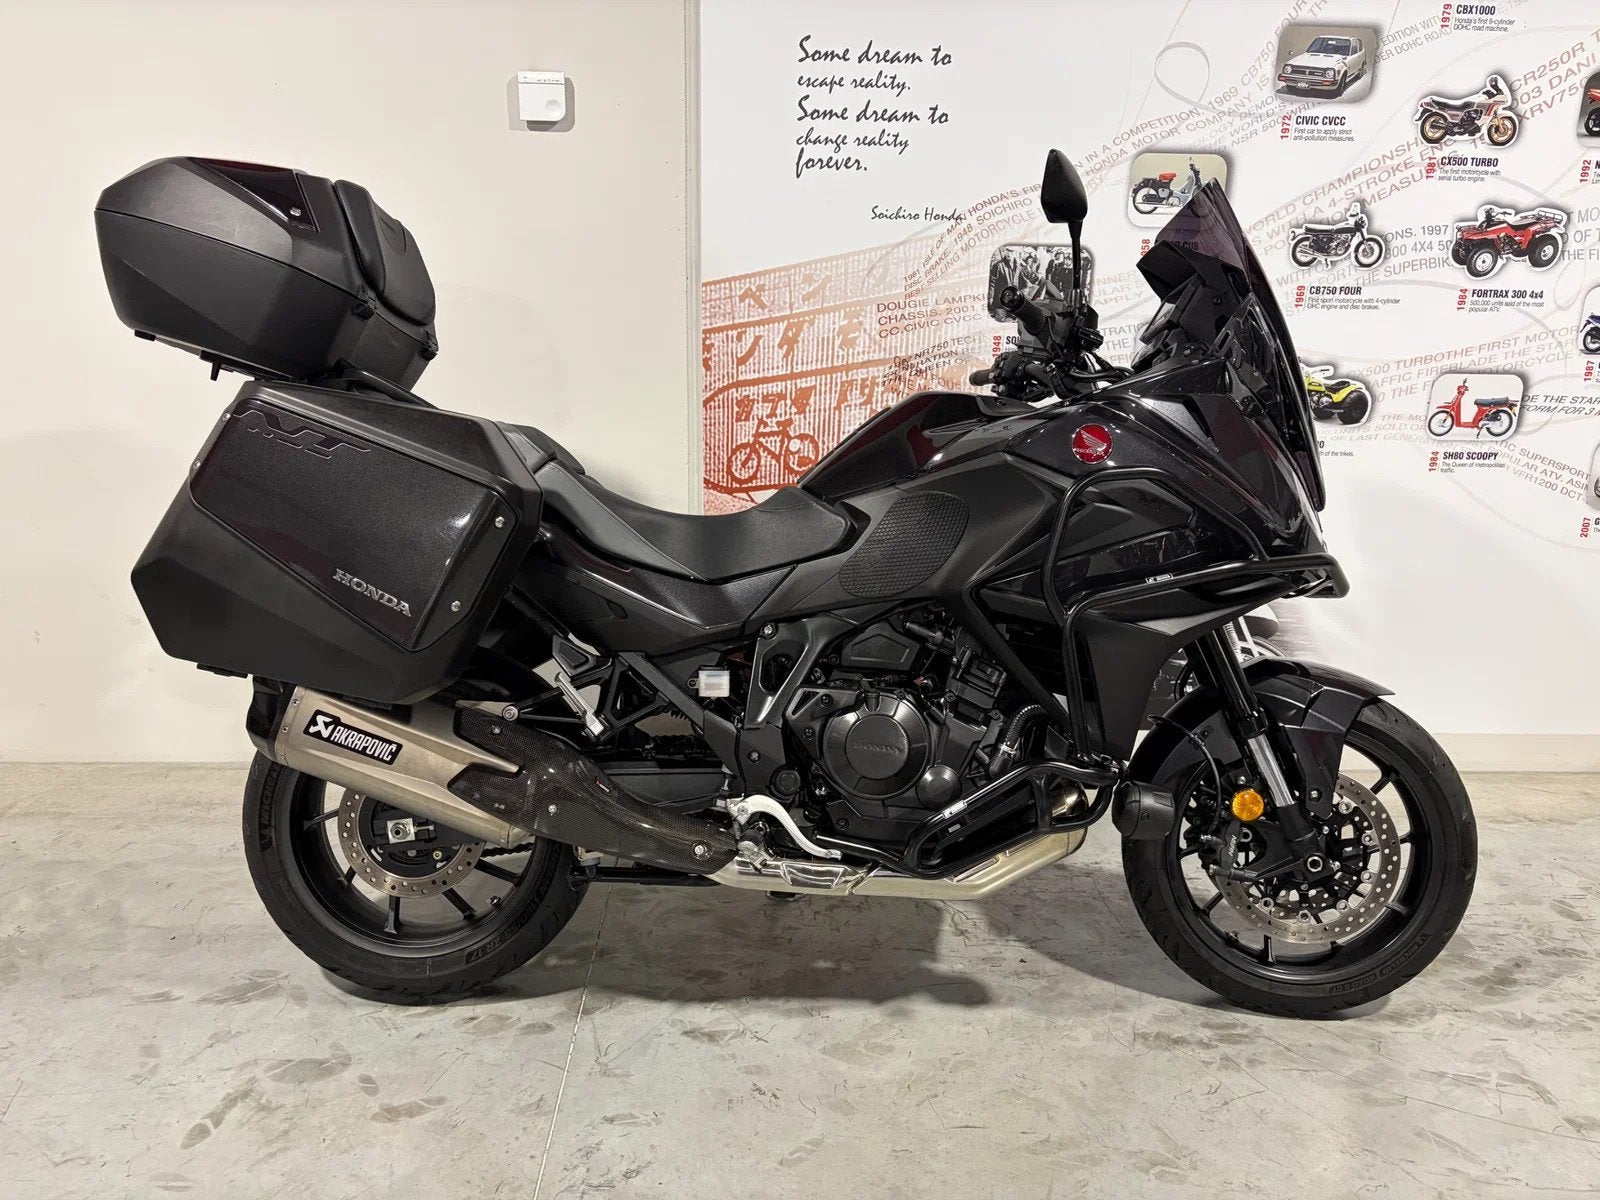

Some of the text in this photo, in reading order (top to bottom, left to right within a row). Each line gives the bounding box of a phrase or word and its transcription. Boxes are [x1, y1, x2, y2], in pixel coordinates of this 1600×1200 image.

[1441, 4, 1452, 29] 1979
[1456, 4, 1496, 15] CBX1000
[798, 34, 952, 66] Some dream to
[797, 70, 911, 98] escape reality.
[797, 94, 950, 124] Some dream to
[1280, 114, 1292, 140] 1972
[1295, 116, 1346, 126] CIVIC CVCC
[796, 126, 910, 155] change reality
[796, 146, 868, 178] forever.
[1426, 156, 1437, 180] 1981
[1440, 156, 1498, 168] CX500 TURBO
[1580, 159, 1592, 183] 1992
[1022, 184, 1042, 194] FIR
[870, 205, 962, 222] Soichiro Honda
[1384, 256, 1450, 278] SUPERBIK
[1295, 285, 1306, 308] 1969
[1309, 286, 1362, 296] CB750 FOUR
[1456, 288, 1468, 311] 1984
[1471, 288, 1510, 298] FORTRAX
[1511, 290, 1527, 298] 300
[876, 293, 988, 313] DOUGIE LAMPKI
[1584, 360, 1594, 382] 1987
[1428, 451, 1440, 472] 1984
[1442, 452, 1498, 460] SH80 SCOOPY
[1580, 517, 1591, 538] 2007
[332, 567, 412, 618] HONDA
